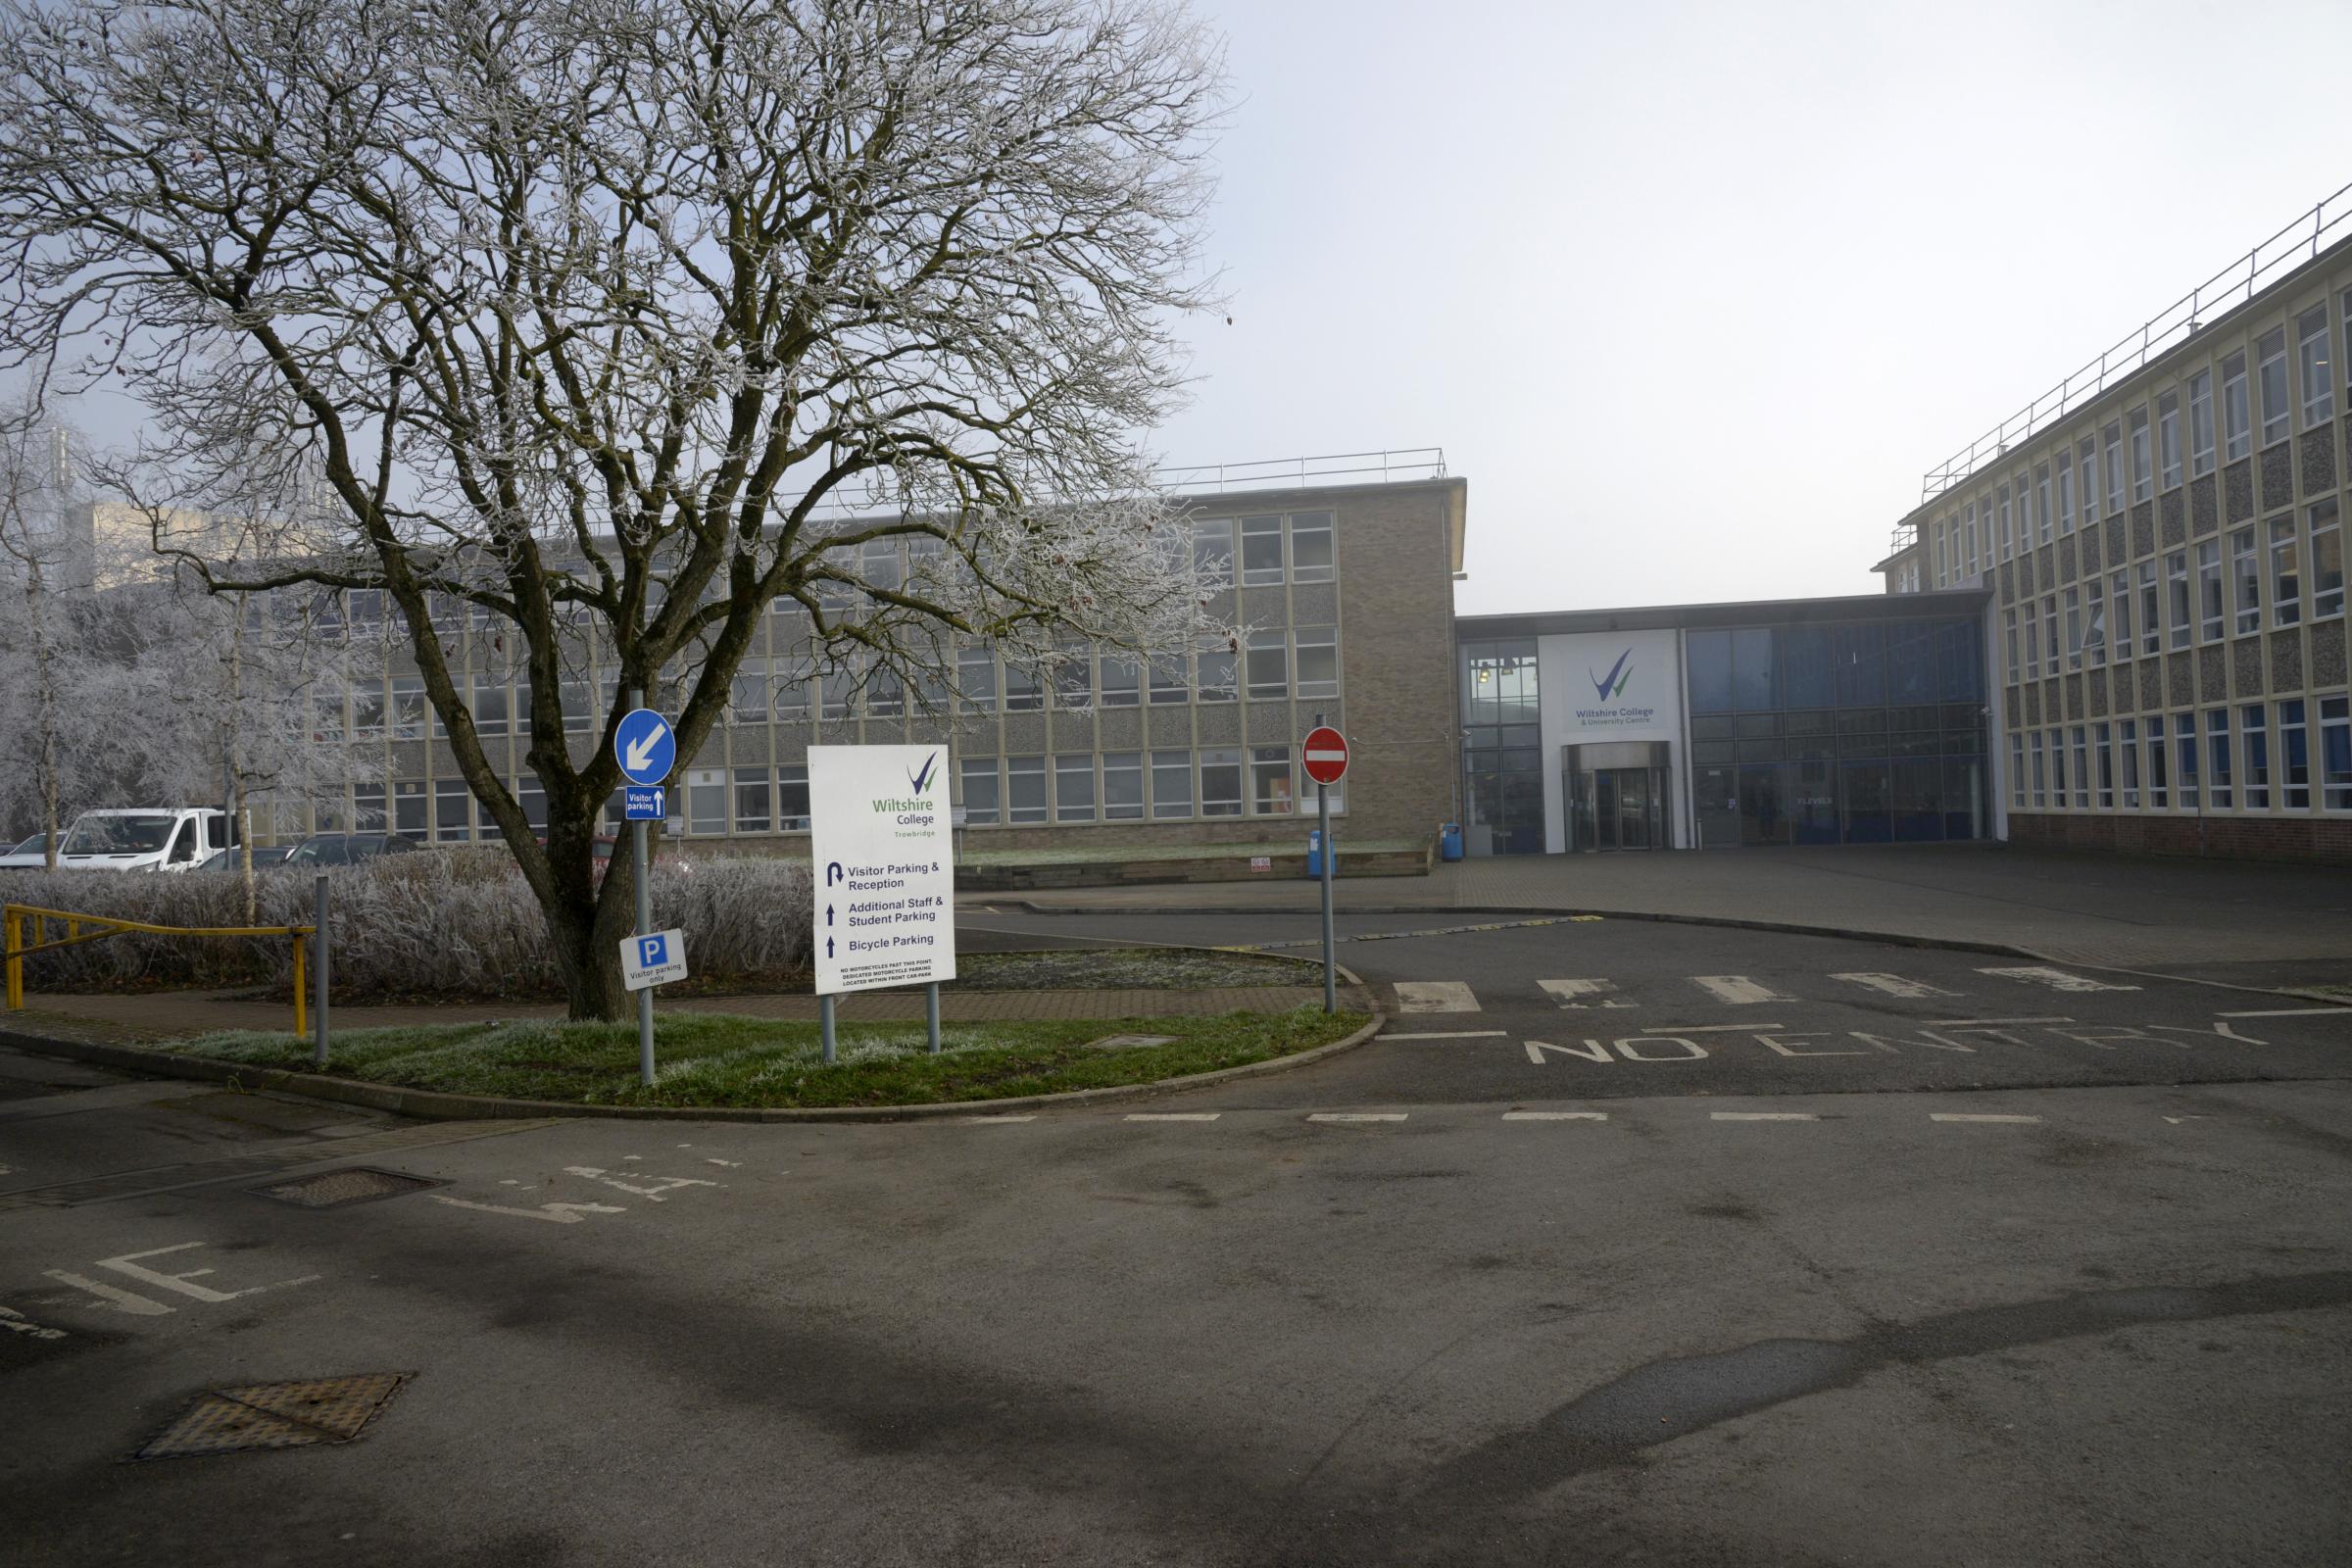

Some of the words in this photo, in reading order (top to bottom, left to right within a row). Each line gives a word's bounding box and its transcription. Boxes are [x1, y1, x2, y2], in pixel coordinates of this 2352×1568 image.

[1576, 710, 1617, 718] Wiltshire
[1619, 708, 1653, 717] College
[628, 793, 652, 802] Visitor
[872, 798, 933, 812] Wiltshire
[627, 803, 654, 811] parking
[897, 813, 934, 826] College
[848, 865, 885, 877] Visitor
[887, 863, 928, 874] Parking
[931, 861, 940, 872] &
[849, 879, 905, 891] Reception
[849, 899, 905, 913] Additional
[907, 897, 933, 908] Staff
[935, 896, 944, 906] &
[849, 914, 892, 927] Student
[895, 910, 936, 923] Parking
[849, 938, 890, 952] Bicycle
[893, 934, 934, 947] Parking
[644, 940, 661, 964] P
[630, 970, 654, 979] Visitor
[656, 963, 682, 975] parking
[842, 971, 872, 980] DEDICATED
[1523, 1037, 1709, 1065] NO
[1753, 1022, 2271, 1057] ENTRY
